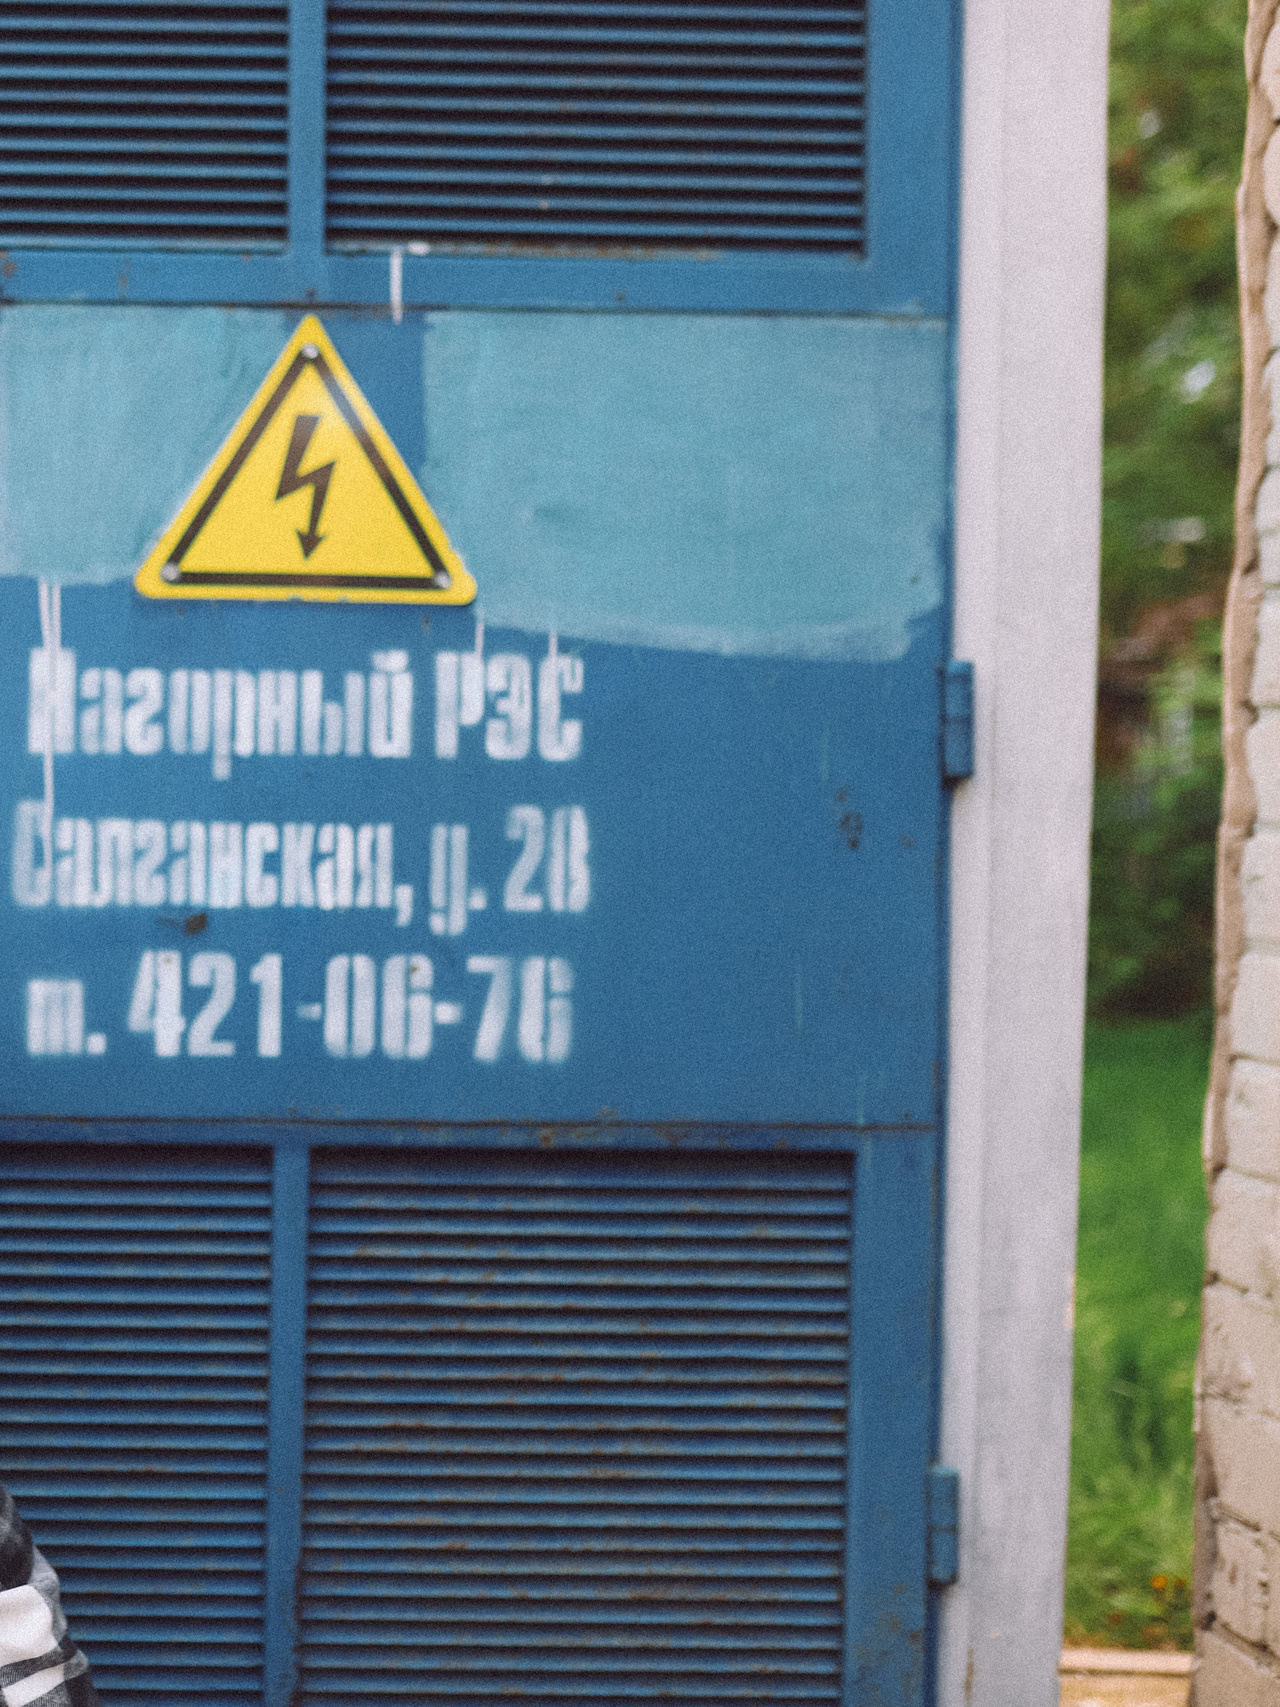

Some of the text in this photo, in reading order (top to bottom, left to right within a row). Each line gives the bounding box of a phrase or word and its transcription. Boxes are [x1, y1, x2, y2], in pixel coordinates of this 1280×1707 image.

[27, 648, 585, 781] Нагорный РЭС
[12, 800, 415, 927] Салганская,
[127, 949, 576, 1063] 421-06-76
